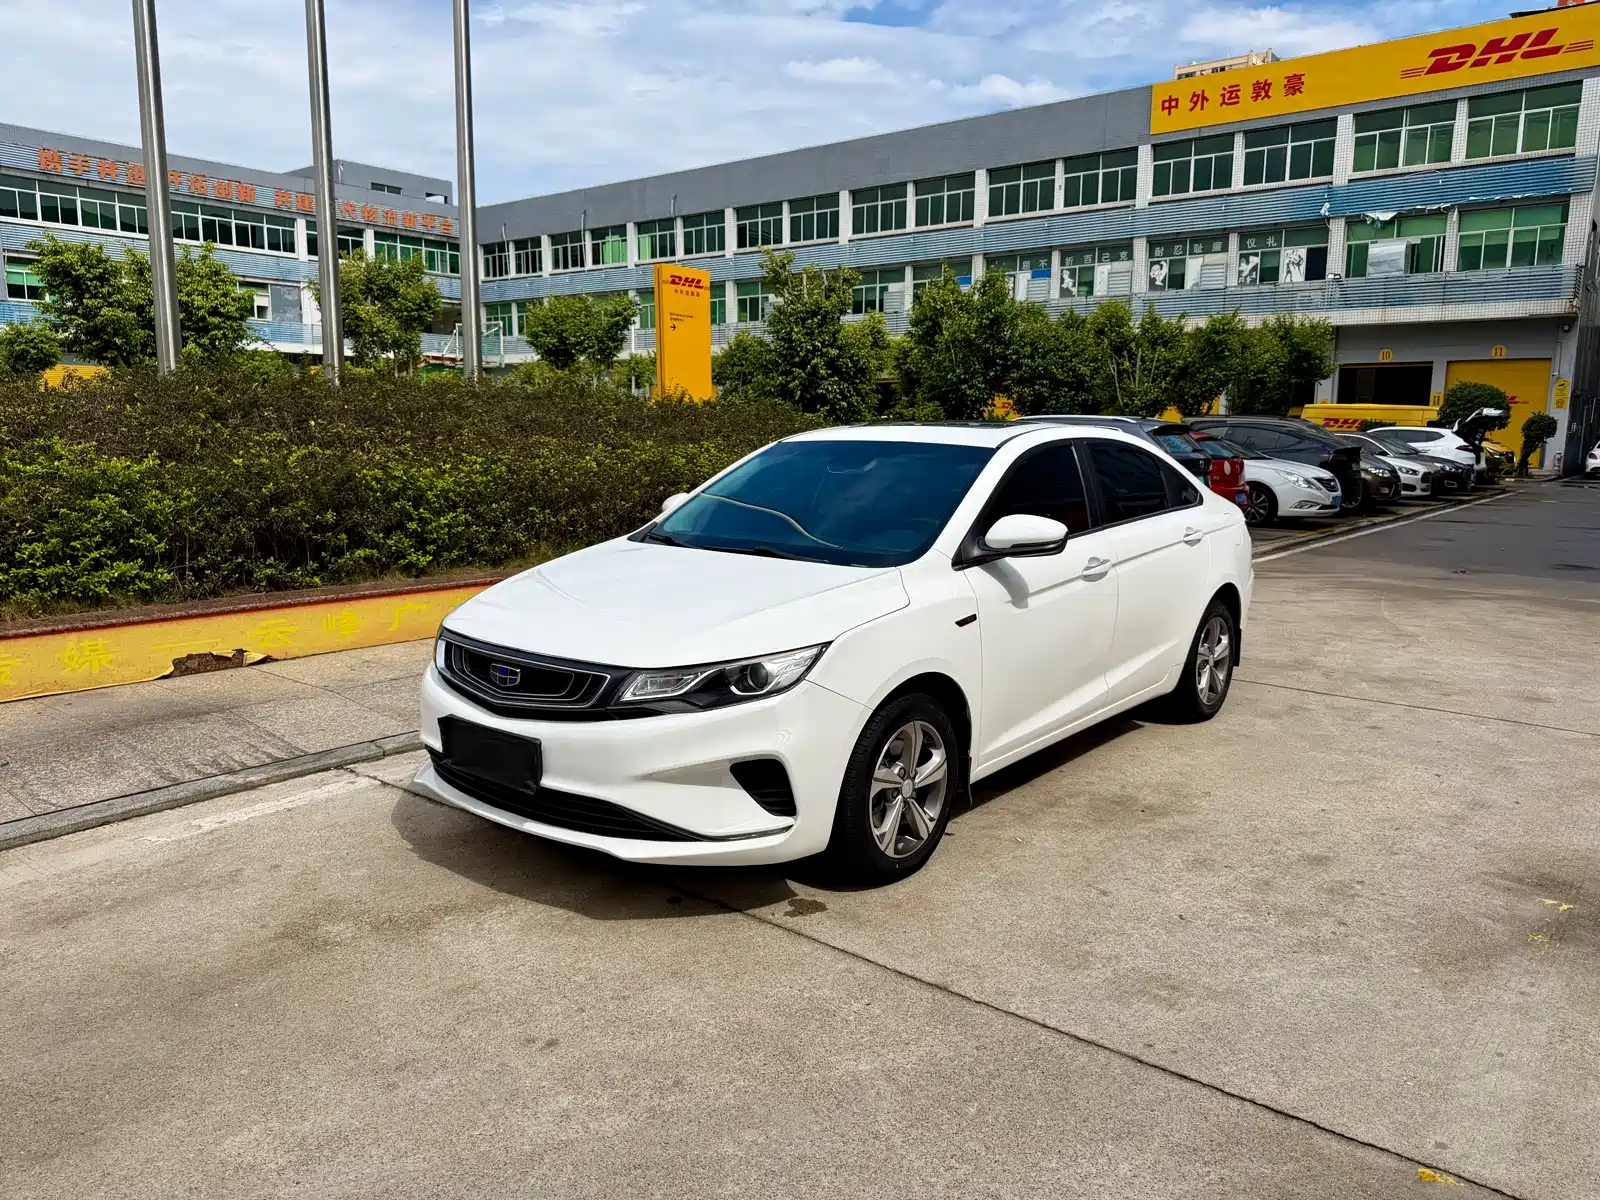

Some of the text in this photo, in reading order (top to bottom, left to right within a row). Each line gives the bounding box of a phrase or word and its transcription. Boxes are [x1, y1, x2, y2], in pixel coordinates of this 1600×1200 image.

[1423, 27, 1566, 76] DHL
[1161, 73, 1305, 116] 中外运敦豪
[274, 189, 455, 236] 共建代物流新平台
[669, 274, 704, 290] DHL
[1381, 350, 1391, 360] 10
[1494, 347, 1503, 356] 11
[1320, 417, 1364, 430] DH
[250, 593, 468, 648] 云峰广
